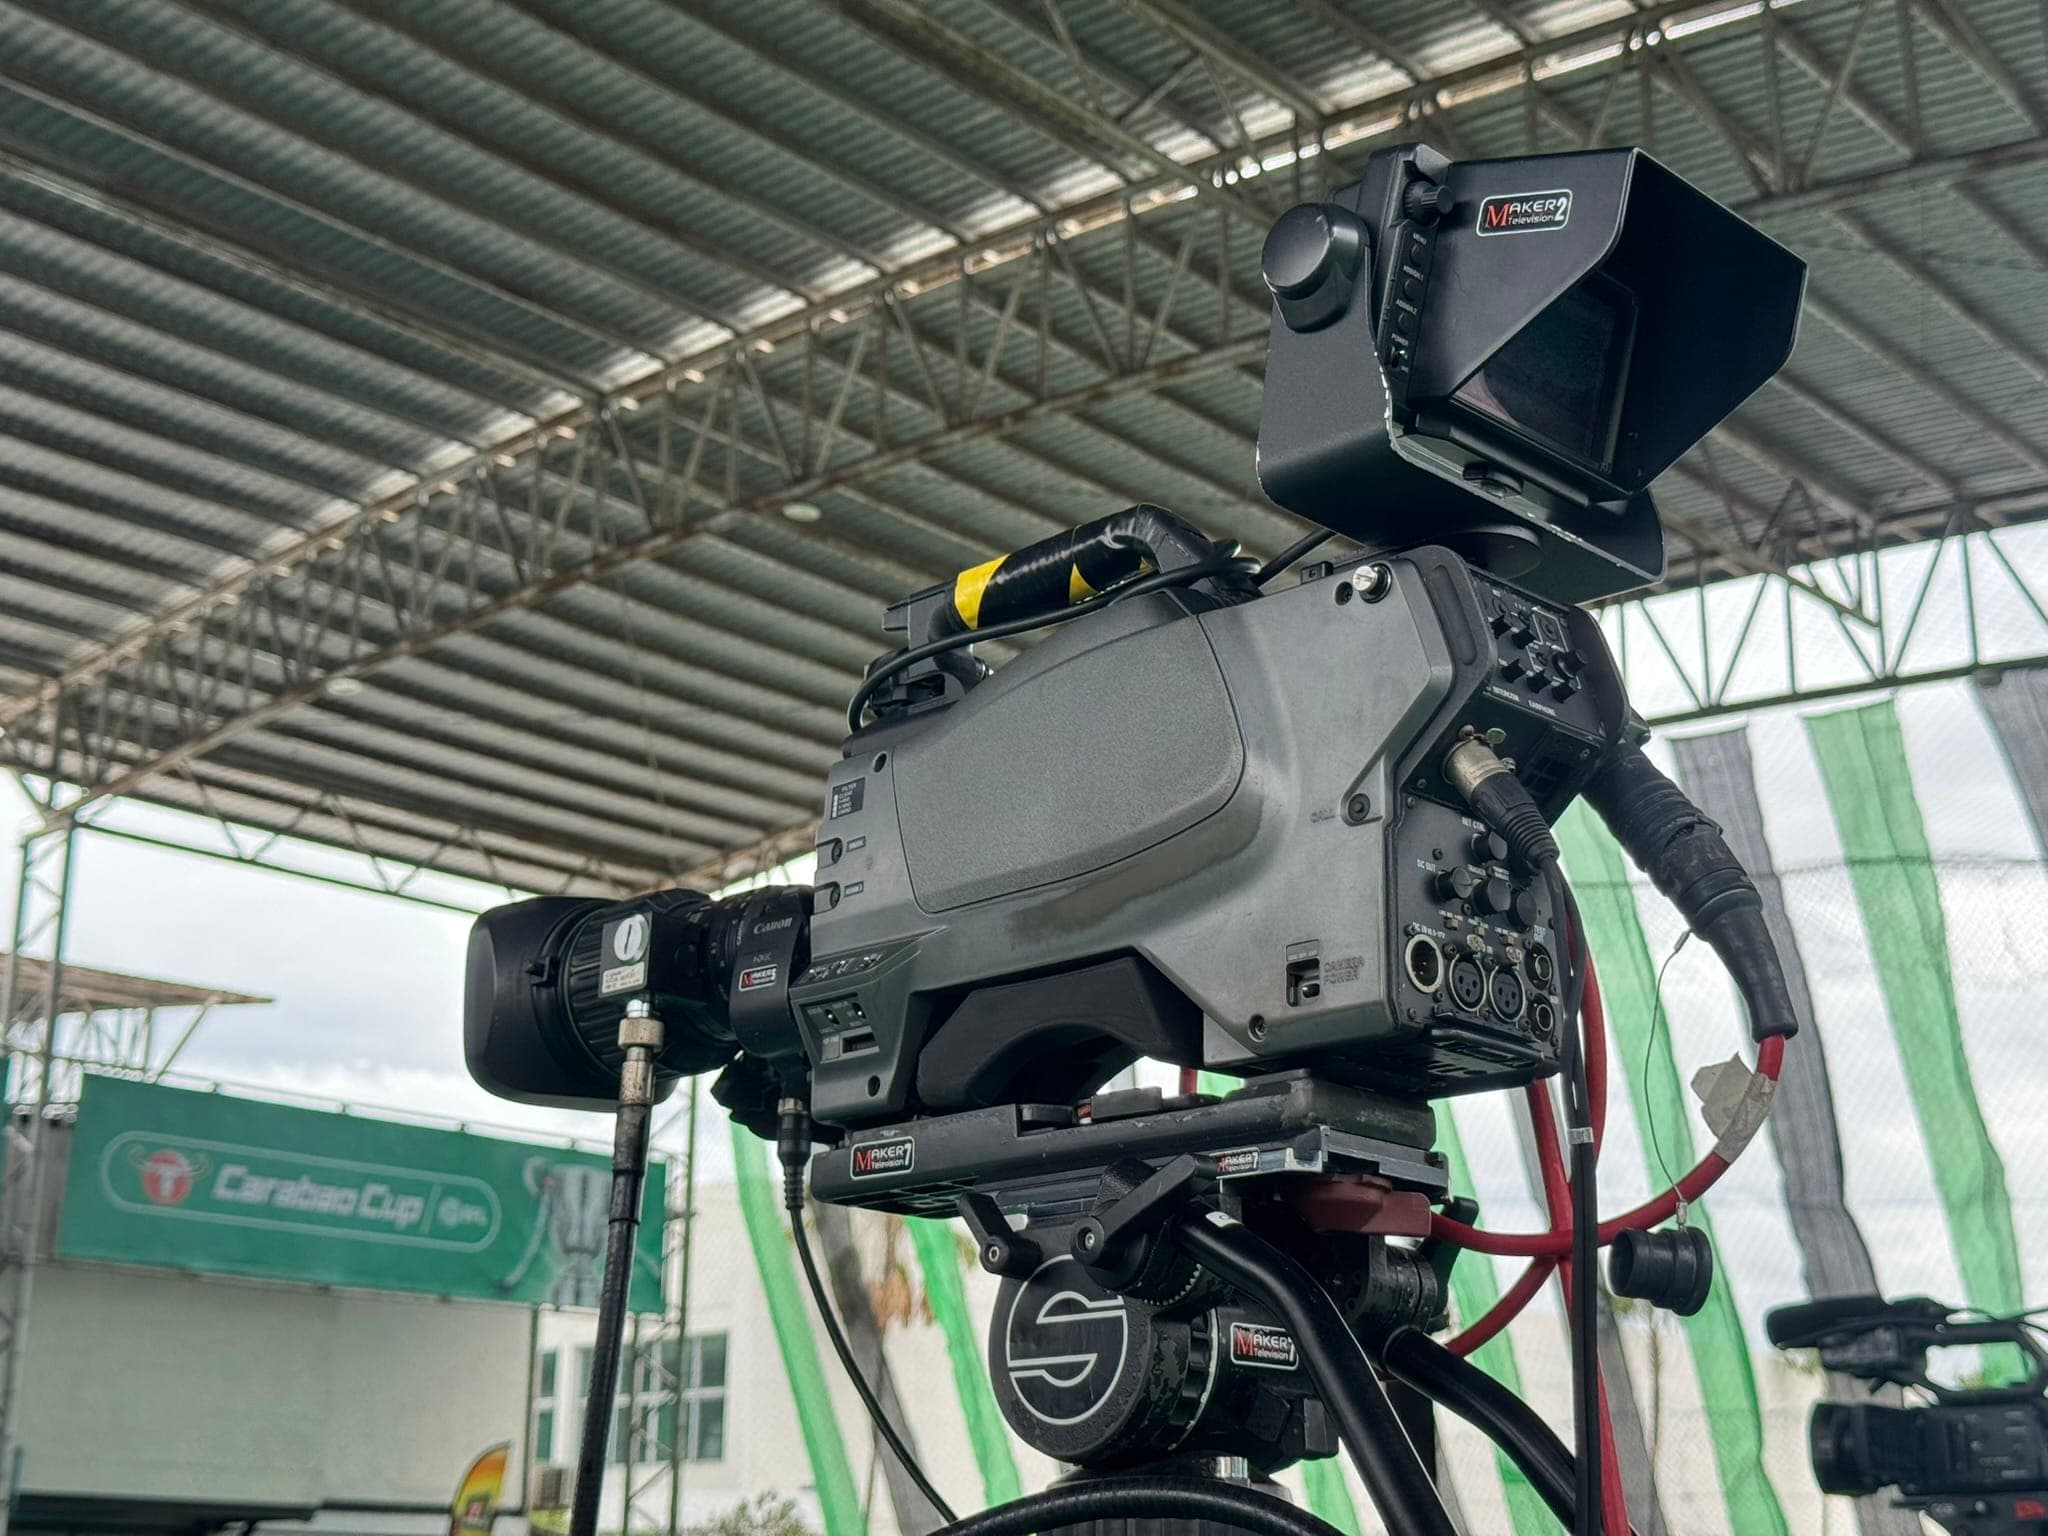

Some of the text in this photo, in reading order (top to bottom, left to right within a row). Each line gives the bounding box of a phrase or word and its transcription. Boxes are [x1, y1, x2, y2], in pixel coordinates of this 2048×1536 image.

[1508, 213, 1554, 225] Television
[213, 1163, 358, 1216] Carabao
[358, 1183, 425, 1230] Cup
